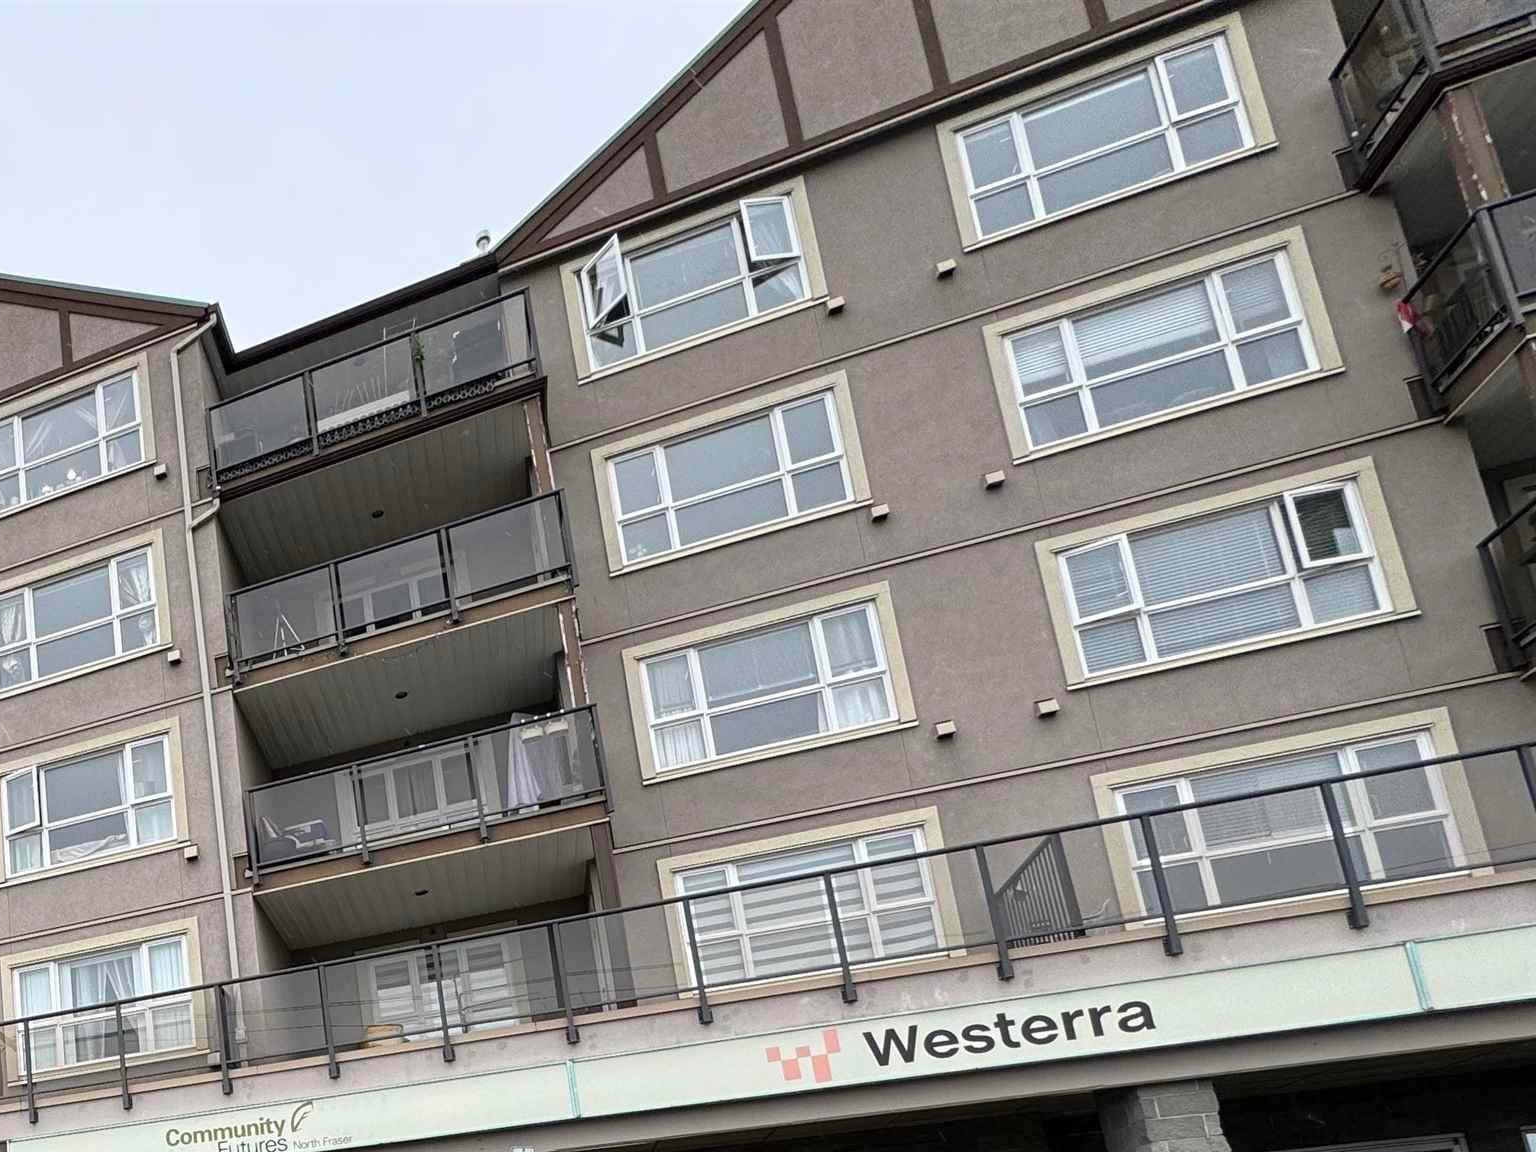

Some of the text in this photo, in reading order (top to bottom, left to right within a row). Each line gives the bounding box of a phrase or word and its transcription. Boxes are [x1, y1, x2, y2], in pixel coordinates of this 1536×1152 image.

[862, 1000, 1156, 1067] Westerra
[165, 1116, 286, 1147] Community
[293, 1138, 322, 1151] North
[323, 1135, 353, 1147] Fraser
